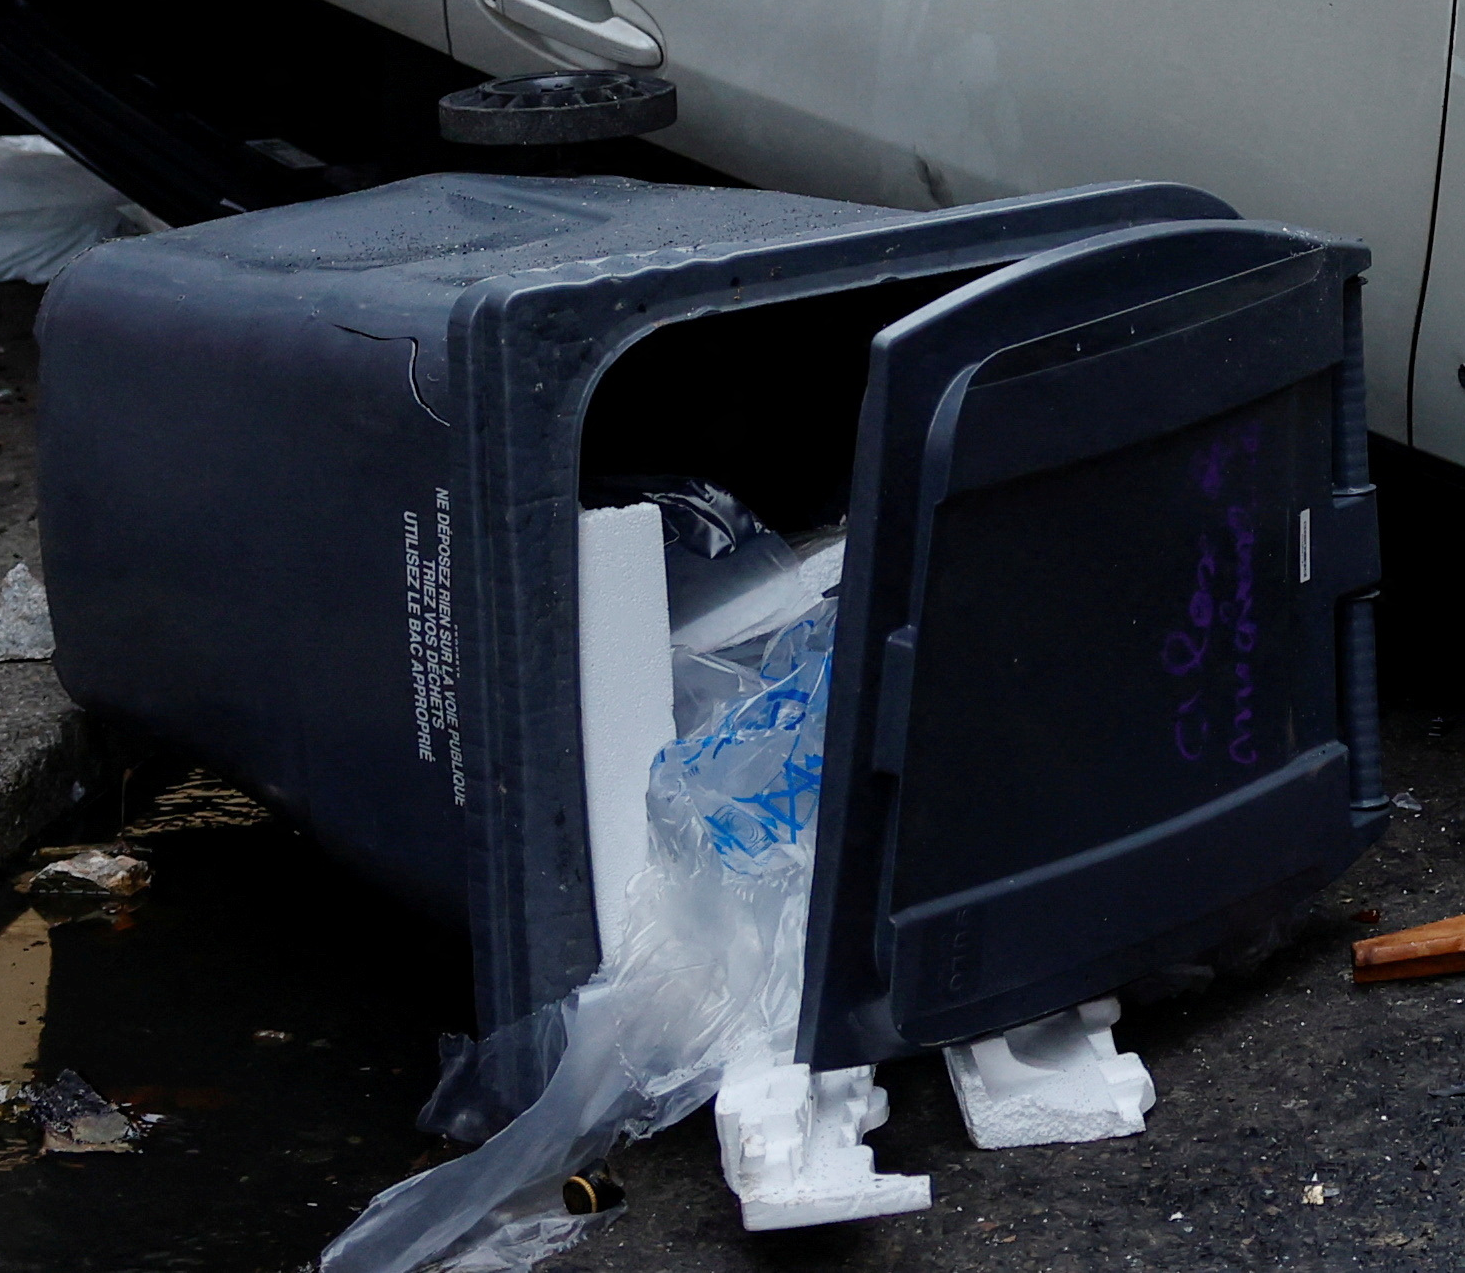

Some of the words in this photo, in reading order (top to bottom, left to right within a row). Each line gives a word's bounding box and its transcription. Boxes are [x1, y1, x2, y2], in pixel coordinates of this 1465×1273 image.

[435, 487, 449, 511] NE
[403, 511, 419, 589] UTILISEZ
[437, 512, 453, 587] DÉPOSEZ
[407, 591, 421, 615] LE
[423, 559, 436, 609] TRIEZ
[438, 588, 451, 627] RIEN
[408, 618, 423, 657] BAC
[424, 612, 438, 647] VOS
[440, 629, 452, 663] SUR
[426, 650, 445, 730] DÉCHETS
[442, 665, 454, 685] LA
[411, 659, 436, 762] APPROPRIÉ
[444, 691, 459, 727] VOIE
[448, 729, 465, 807] PUBLIQUE
